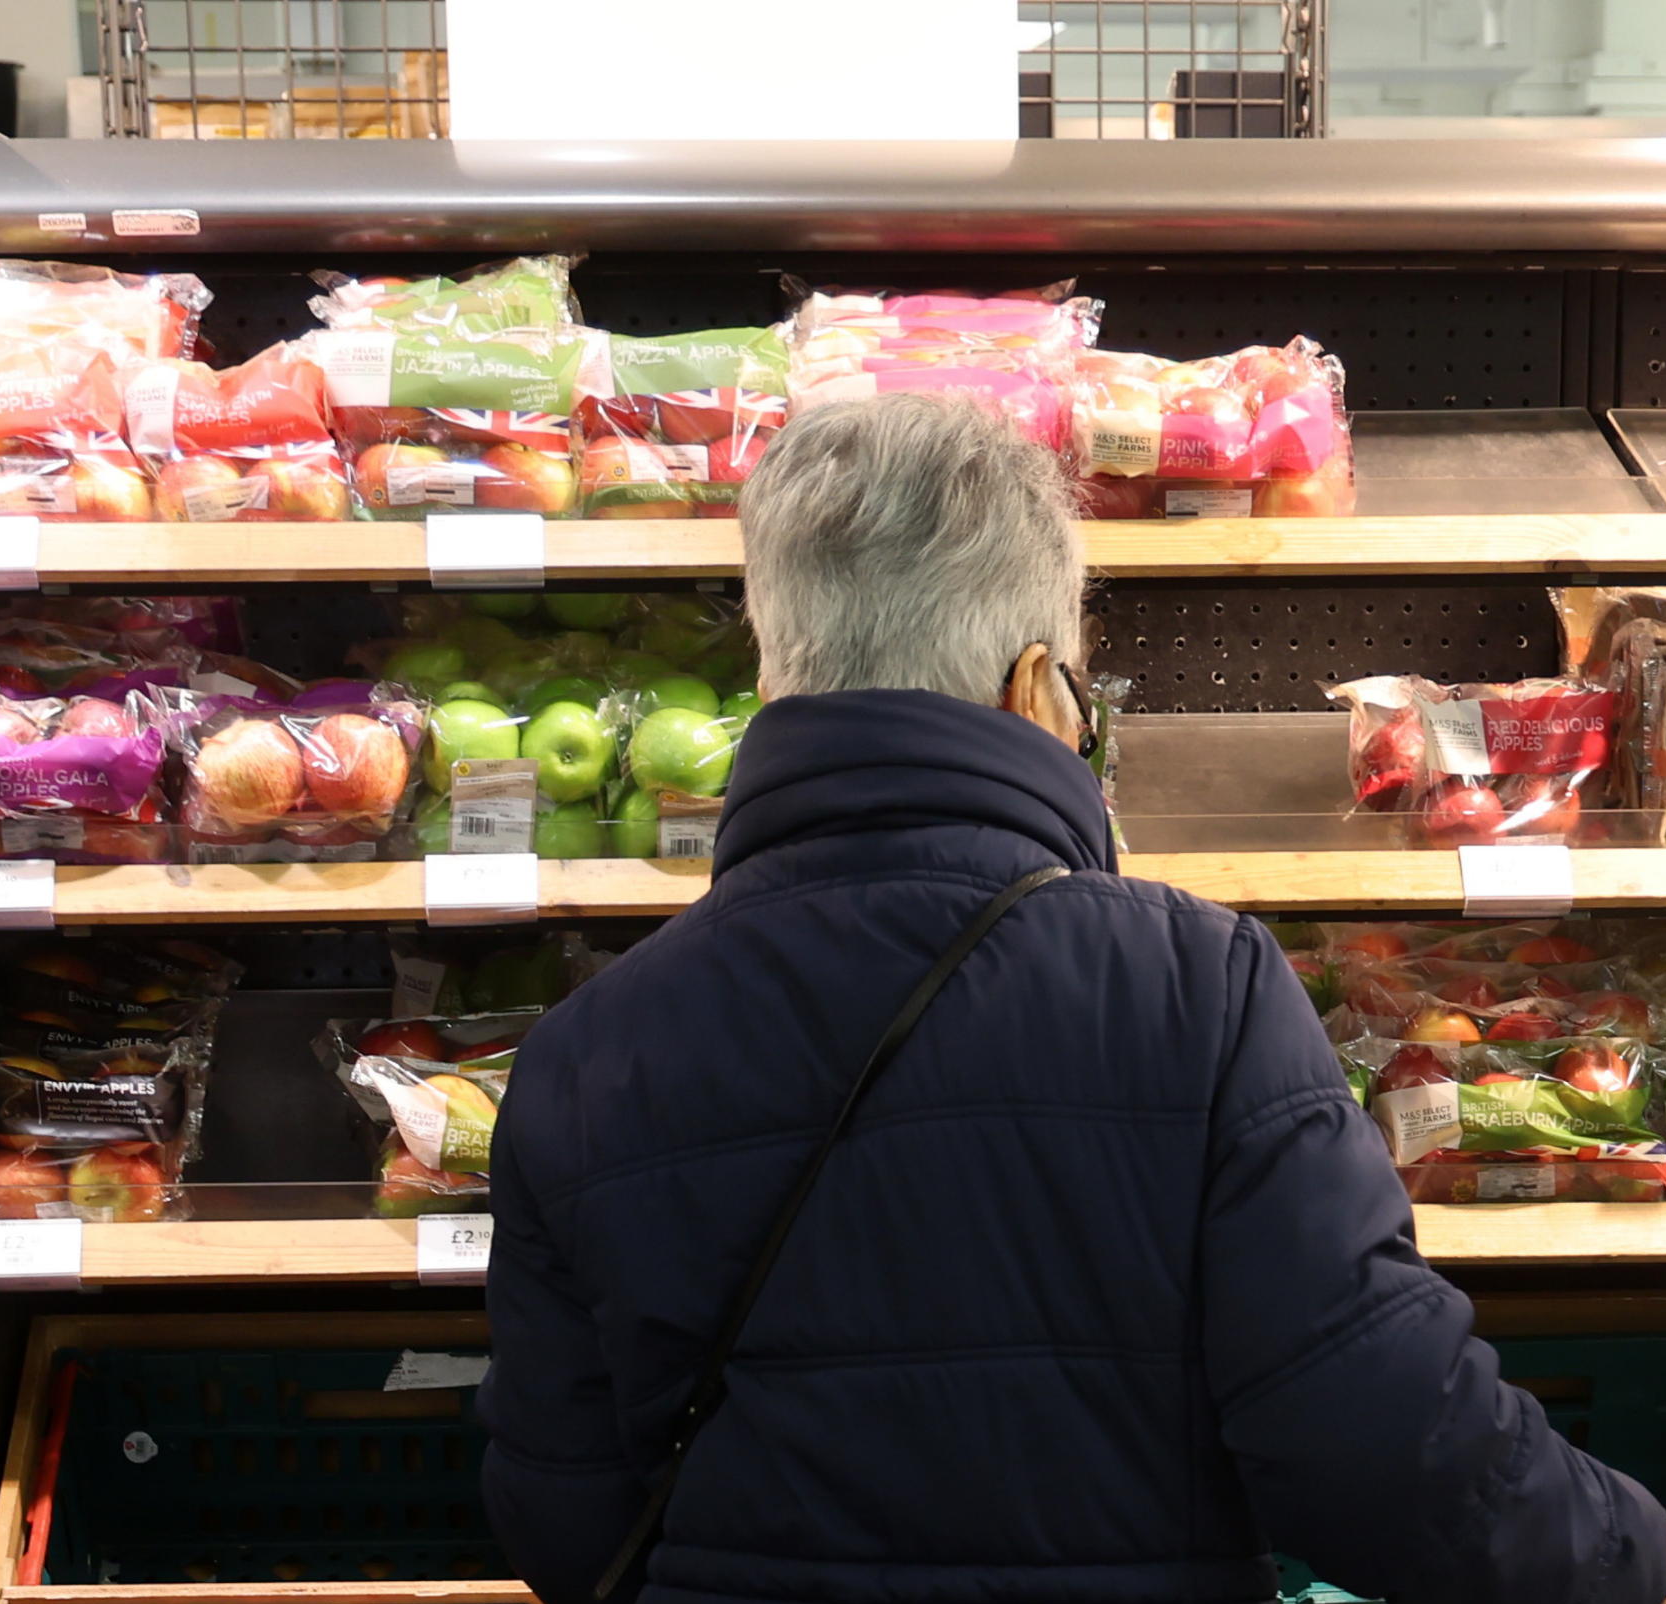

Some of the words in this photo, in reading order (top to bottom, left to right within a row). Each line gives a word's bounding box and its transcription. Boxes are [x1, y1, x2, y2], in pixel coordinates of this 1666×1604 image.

[1093, 432, 1116, 443] M&S
[1118, 435, 1152, 444] SELECT
[1118, 443, 1152, 453] FARMS
[1487, 719, 1521, 737] RED
[1522, 716, 1606, 736] DELICIOUS
[1491, 735, 1544, 751] APPLES
[54, 769, 110, 786] GALA
[99, 1081, 156, 1096] APPLES
[1399, 1111, 1422, 1121] M&S
[1422, 1105, 1452, 1115] SELECT
[1462, 1101, 1507, 1112] BRITISH
[1422, 1113, 1452, 1124] FARMS
[1462, 1111, 1559, 1130] BRAEBURN
[451, 1230, 491, 1245] £2.10
